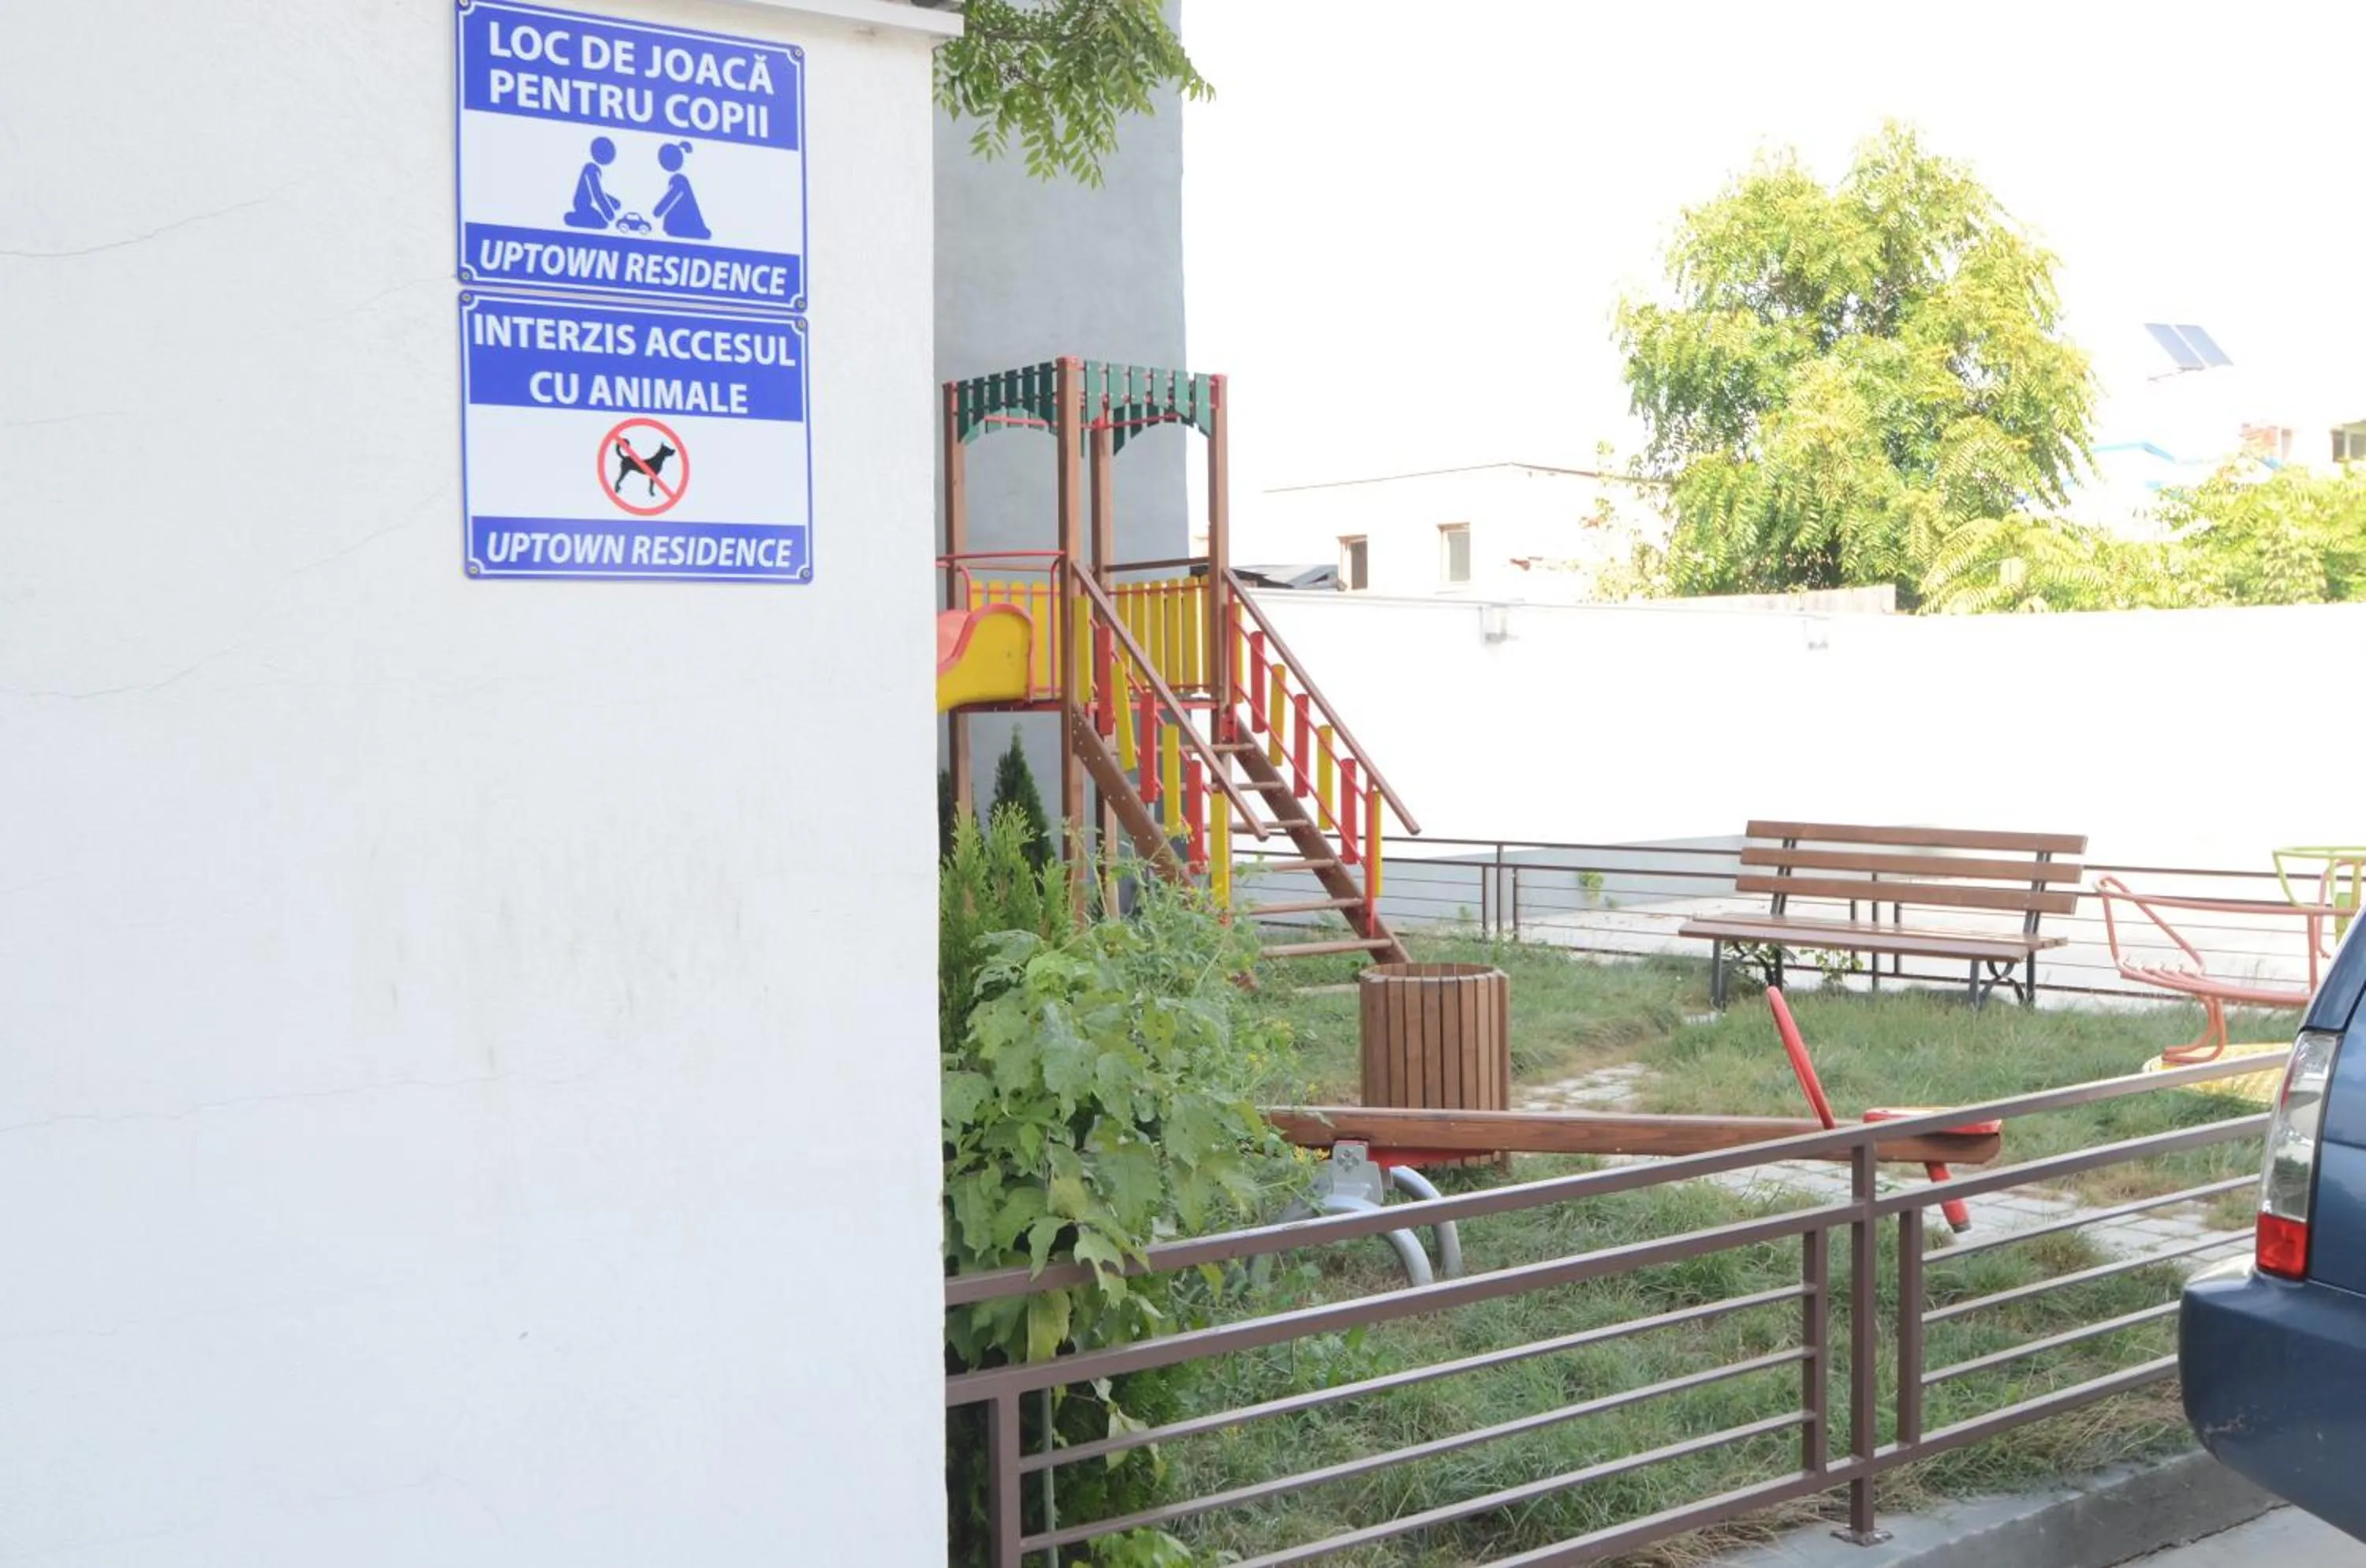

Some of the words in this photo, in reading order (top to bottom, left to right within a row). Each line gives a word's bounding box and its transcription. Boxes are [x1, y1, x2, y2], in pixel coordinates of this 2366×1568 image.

[488, 21, 570, 65] LOC
[581, 35, 636, 75] DE
[644, 46, 774, 95] JOACĂ
[490, 69, 653, 122] PENTRU
[665, 94, 769, 138] COPII
[480, 239, 619, 281] UPTOWN
[625, 253, 787, 296] RESIDENCE
[473, 313, 636, 356] INTERZIS
[644, 327, 796, 367] ACCESUL
[529, 371, 579, 405] CU
[588, 375, 748, 413] ANIMALE
[487, 532, 625, 565] UPTOWN
[631, 536, 793, 568] RESIDENCE
